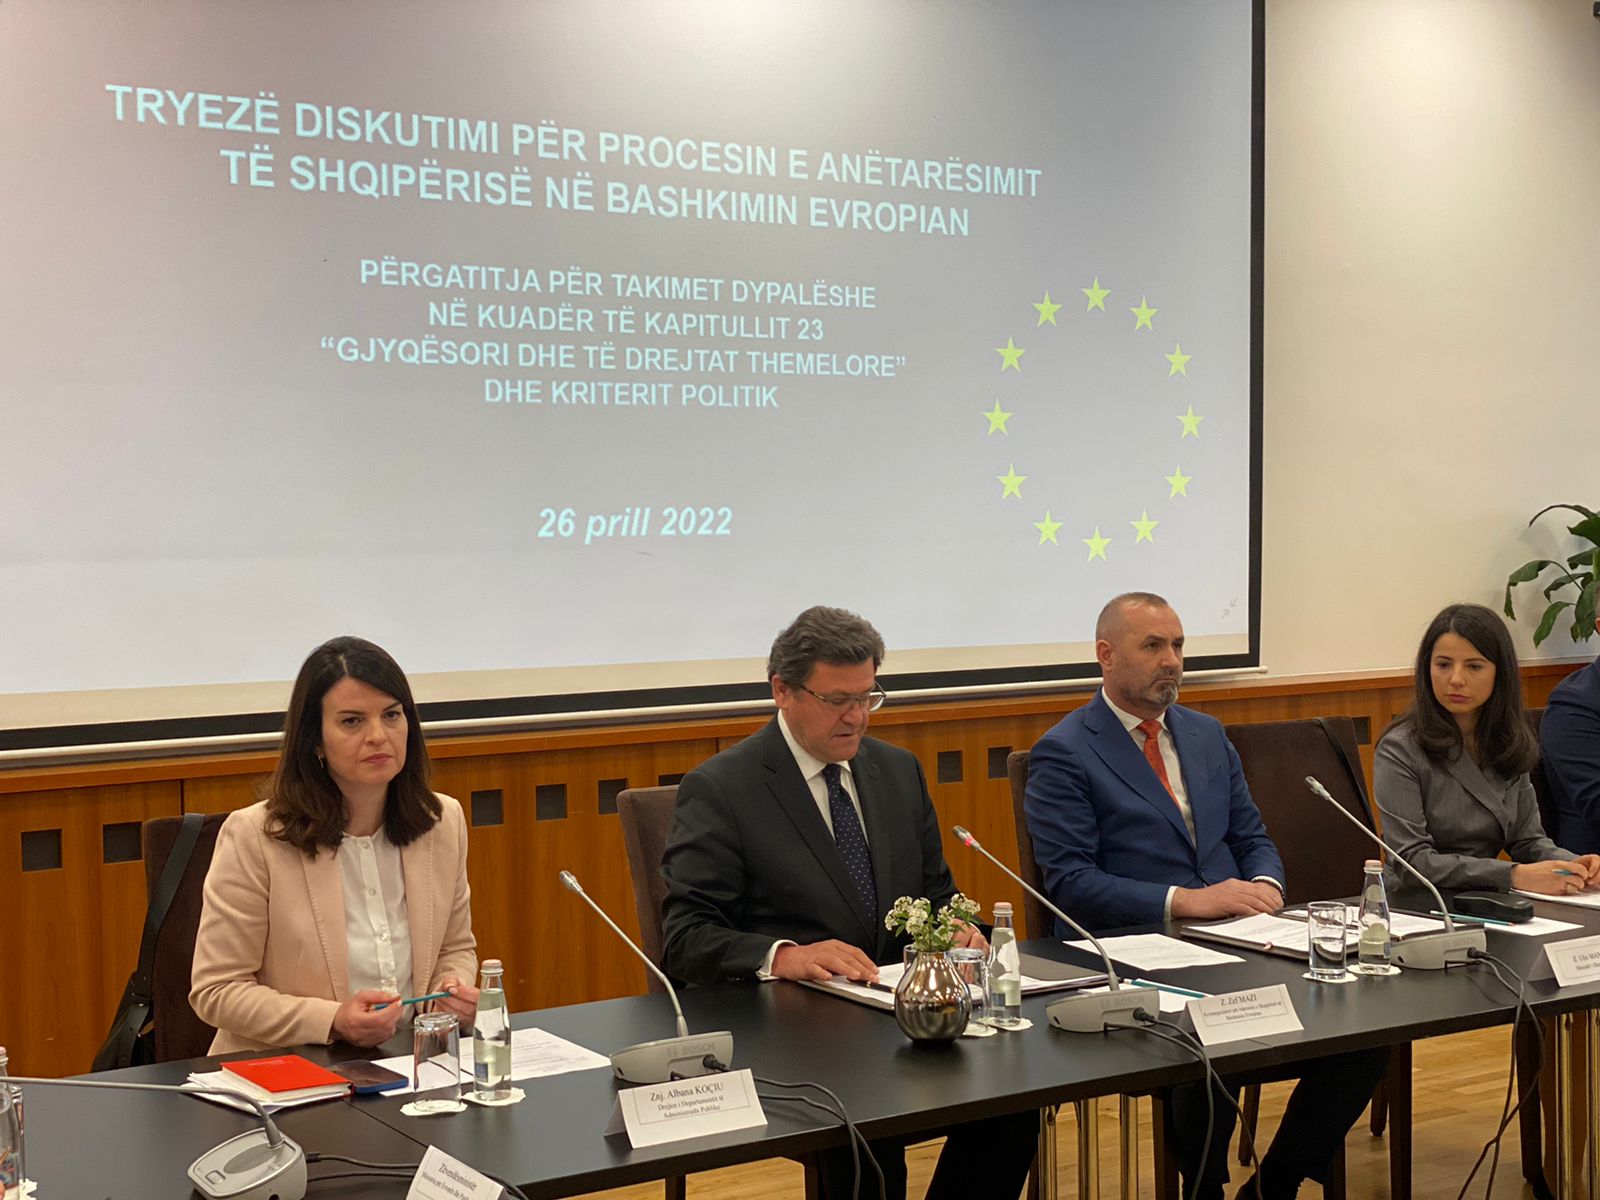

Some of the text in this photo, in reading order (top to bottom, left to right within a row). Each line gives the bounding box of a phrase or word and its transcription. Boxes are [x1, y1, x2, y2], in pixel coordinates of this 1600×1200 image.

[104, 83, 1043, 197] TRYEZË DISKUTIMI PËR PROCESIN E ANËTARËSIMIT
[219, 143, 969, 237] TË SHQIPËRISË NË BASHKIMIN EVROPIAN
[359, 254, 877, 309] PËRGATITJA PËR TAKIMET DYPALËSHE
[428, 296, 824, 341] NË KUADËR TË KAPITULLIT 23
[517, 342, 576, 369] DHE
[582, 340, 617, 370] TË
[625, 346, 740, 373] DREJTAT
[484, 378, 779, 408] DHE KRITERIT POLITIK
[537, 505, 733, 545] 26 prill 2022
[667, 1088, 694, 1099] Albana
[694, 1082, 724, 1094] KOÇIU
